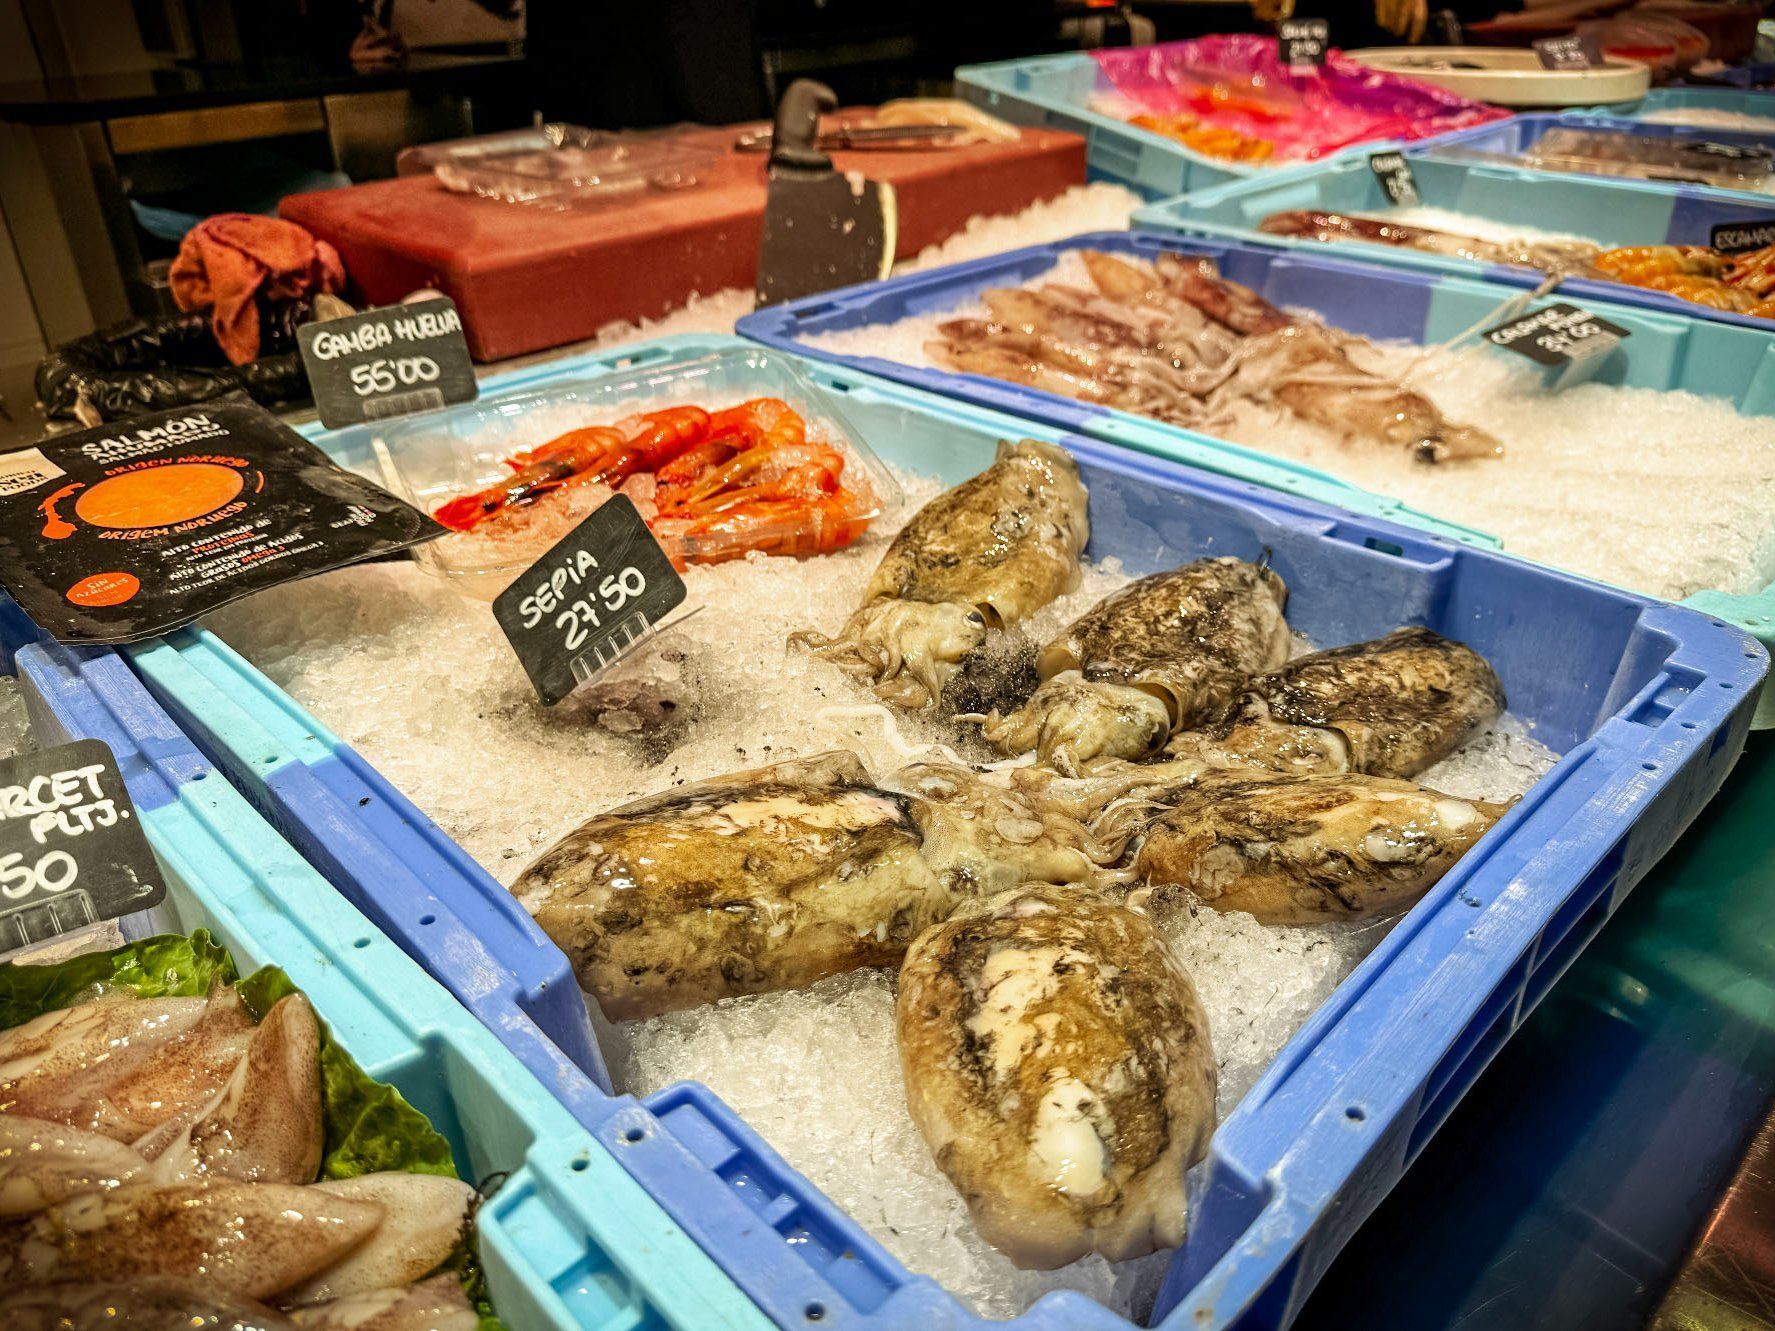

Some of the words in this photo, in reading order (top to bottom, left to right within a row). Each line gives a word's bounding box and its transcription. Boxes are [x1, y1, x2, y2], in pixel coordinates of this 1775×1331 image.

[312, 322, 392, 361] GAMBA
[350, 356, 441, 396] 55'00
[81, 414, 210, 456] SALMÓN
[86, 578, 109, 590] SIN
[555, 566, 646, 650] 27'50
[0, 764, 105, 821] RCET
